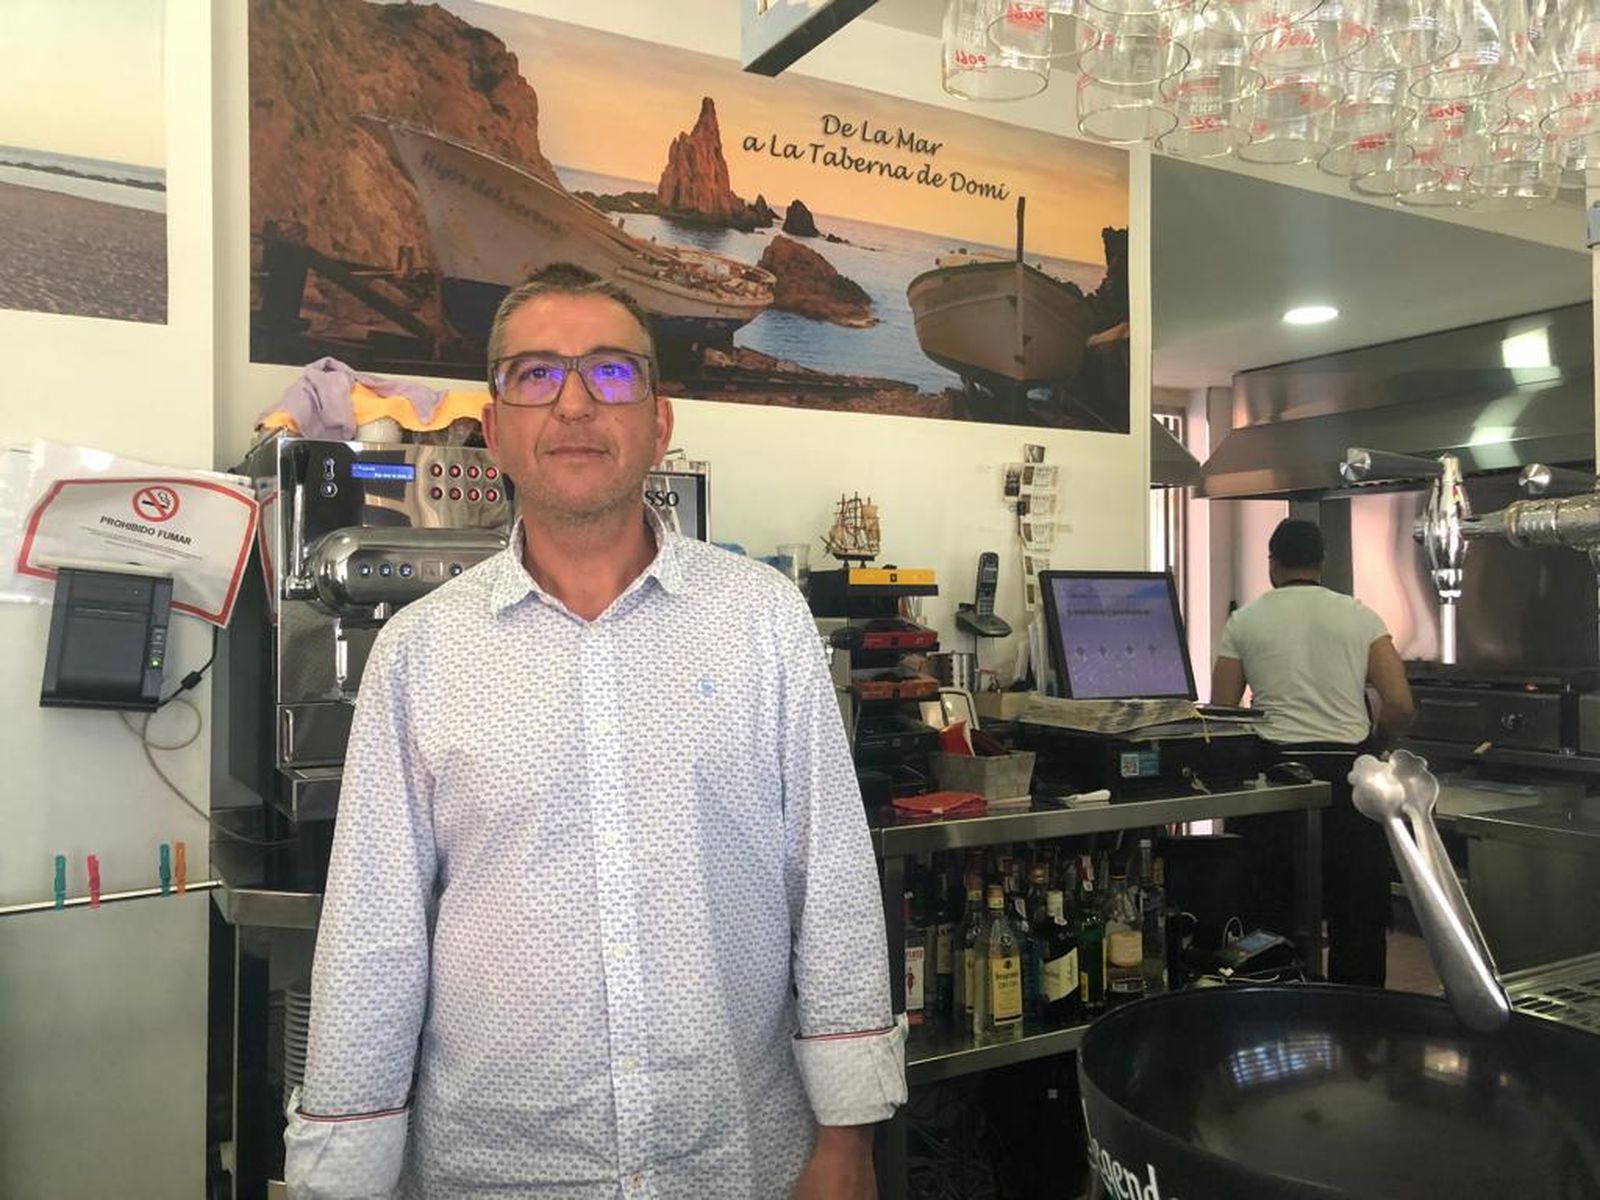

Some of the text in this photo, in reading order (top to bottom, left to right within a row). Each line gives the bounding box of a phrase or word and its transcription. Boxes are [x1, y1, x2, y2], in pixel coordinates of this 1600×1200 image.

[821, 113, 943, 156] De La Mar
[743, 134, 1010, 200] a La Taberna de Domi
[100, 515, 192, 545] PROHIBIDO FUMAR
